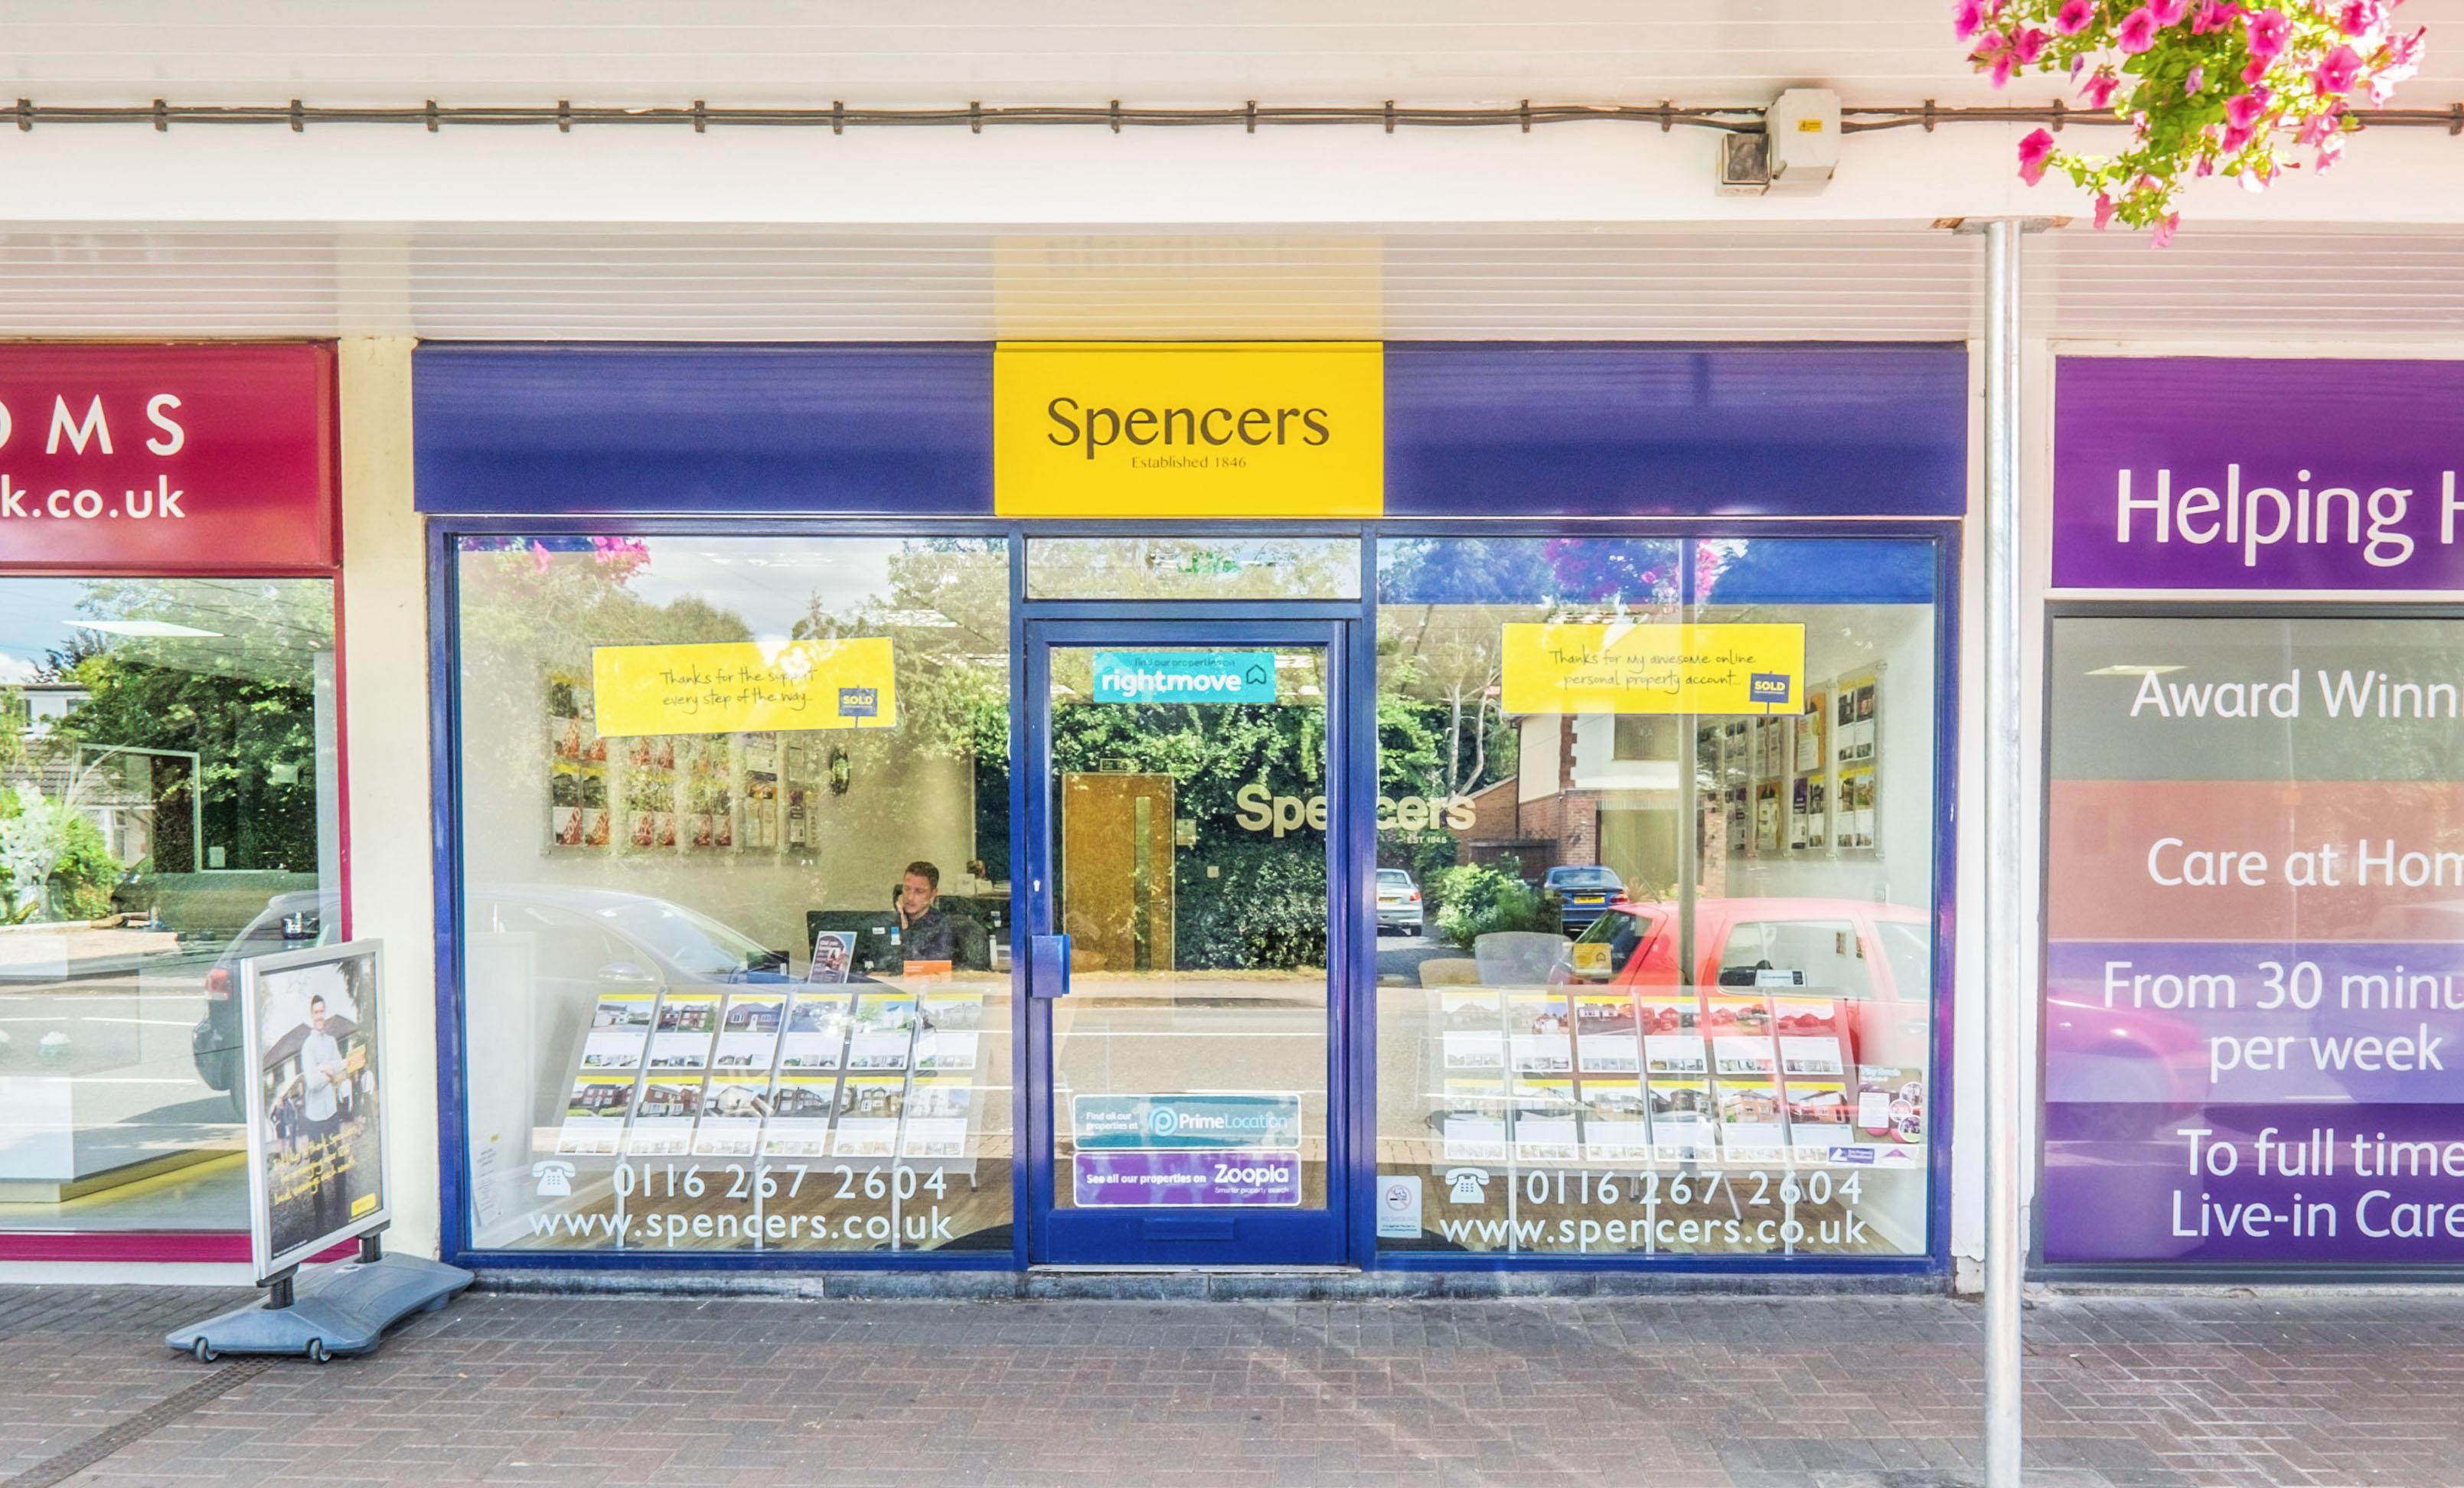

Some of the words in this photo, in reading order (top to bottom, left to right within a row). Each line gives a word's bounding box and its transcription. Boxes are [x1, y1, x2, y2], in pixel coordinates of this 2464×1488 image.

[0, 393, 185, 456] MS
[1047, 396, 1330, 460] Spencers
[1131, 455, 1209, 469] Established
[1216, 456, 1247, 469] 1846
[1, 474, 186, 519] k.co.uk
[2116, 463, 2415, 567] Helping
[1549, 644, 1598, 665] Thanks
[1603, 649, 1622, 665] for
[1715, 649, 1756, 664] online
[660, 664, 712, 686] Thanks
[716, 668, 735, 684] for
[740, 667, 765, 685] the
[769, 667, 818, 687] suppt
[1101, 668, 1242, 697] rightmove
[1562, 670, 1620, 690] personal
[1626, 669, 1680, 694] property
[1754, 680, 1786, 691] SOLD
[2129, 668, 2300, 718] Award
[2317, 669, 2456, 719] Winn
[663, 693, 698, 715] every
[703, 689, 732, 710] step
[736, 688, 749, 703] of
[752, 686, 777, 704] the
[843, 694, 873, 705] SOLD
[1235, 784, 1477, 838] Specers
[2147, 837, 2268, 886] Care
[2284, 843, 2341, 886] at
[2357, 838, 2464, 887] Hom
[2103, 961, 2236, 1009] From
[2256, 961, 2323, 1010] 30
[2340, 965, 2464, 1010] minu
[2210, 1034, 2296, 1084] per
[2309, 1023, 2444, 1071] week
[1180, 1113, 1288, 1130] PrimeLocation
[2176, 1128, 2237, 1176] To
[2254, 1127, 2335, 1176] full
[2351, 1132, 2464, 1177] time
[613, 1163, 706, 1198] 0116
[724, 1163, 809, 1199] 267
[833, 1165, 948, 1201] 2604
[1086, 1174, 1105, 1184] See
[1106, 1173, 1119, 1183] all
[1121, 1175, 1138, 1183] our
[1140, 1173, 1192, 1185] properties
[1193, 1175, 1207, 1183] on
[1214, 1163, 1289, 1187] Zoopla
[1526, 1170, 1620, 1205] 0116
[1638, 1170, 1724, 1206] 267
[1748, 1170, 1863, 1205] 2604
[528, 1205, 955, 1248] www.spencers.co.uk
[1439, 1209, 1868, 1254] www.spencers.co.uk
[2171, 1189, 2337, 1237] Live-in
[2355, 1189, 2464, 1238] Care
